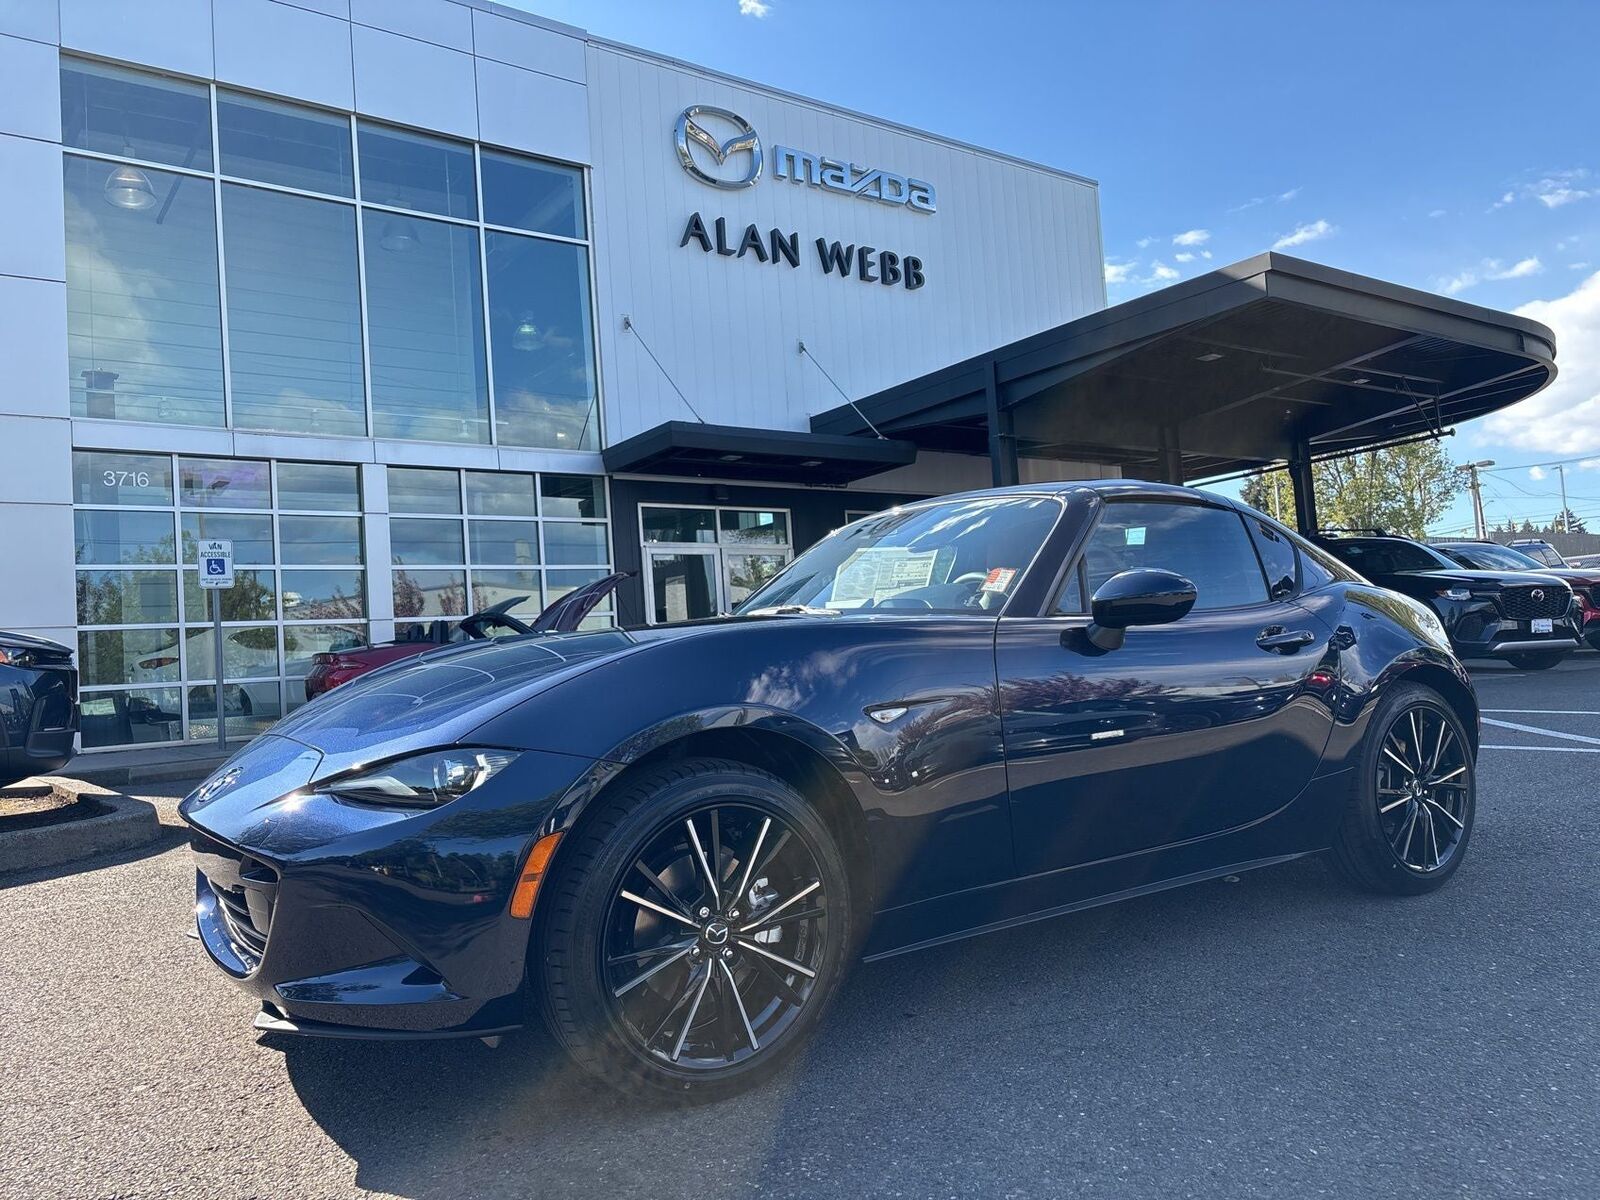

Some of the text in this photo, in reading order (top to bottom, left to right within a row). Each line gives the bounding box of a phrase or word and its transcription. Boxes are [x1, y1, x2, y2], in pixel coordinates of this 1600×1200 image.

[680, 211, 926, 290] ALAN WEBB
[103, 470, 149, 487] 3716
[208, 542, 222, 550] VAN
[200, 551, 231, 559] ACCESSIBLE
